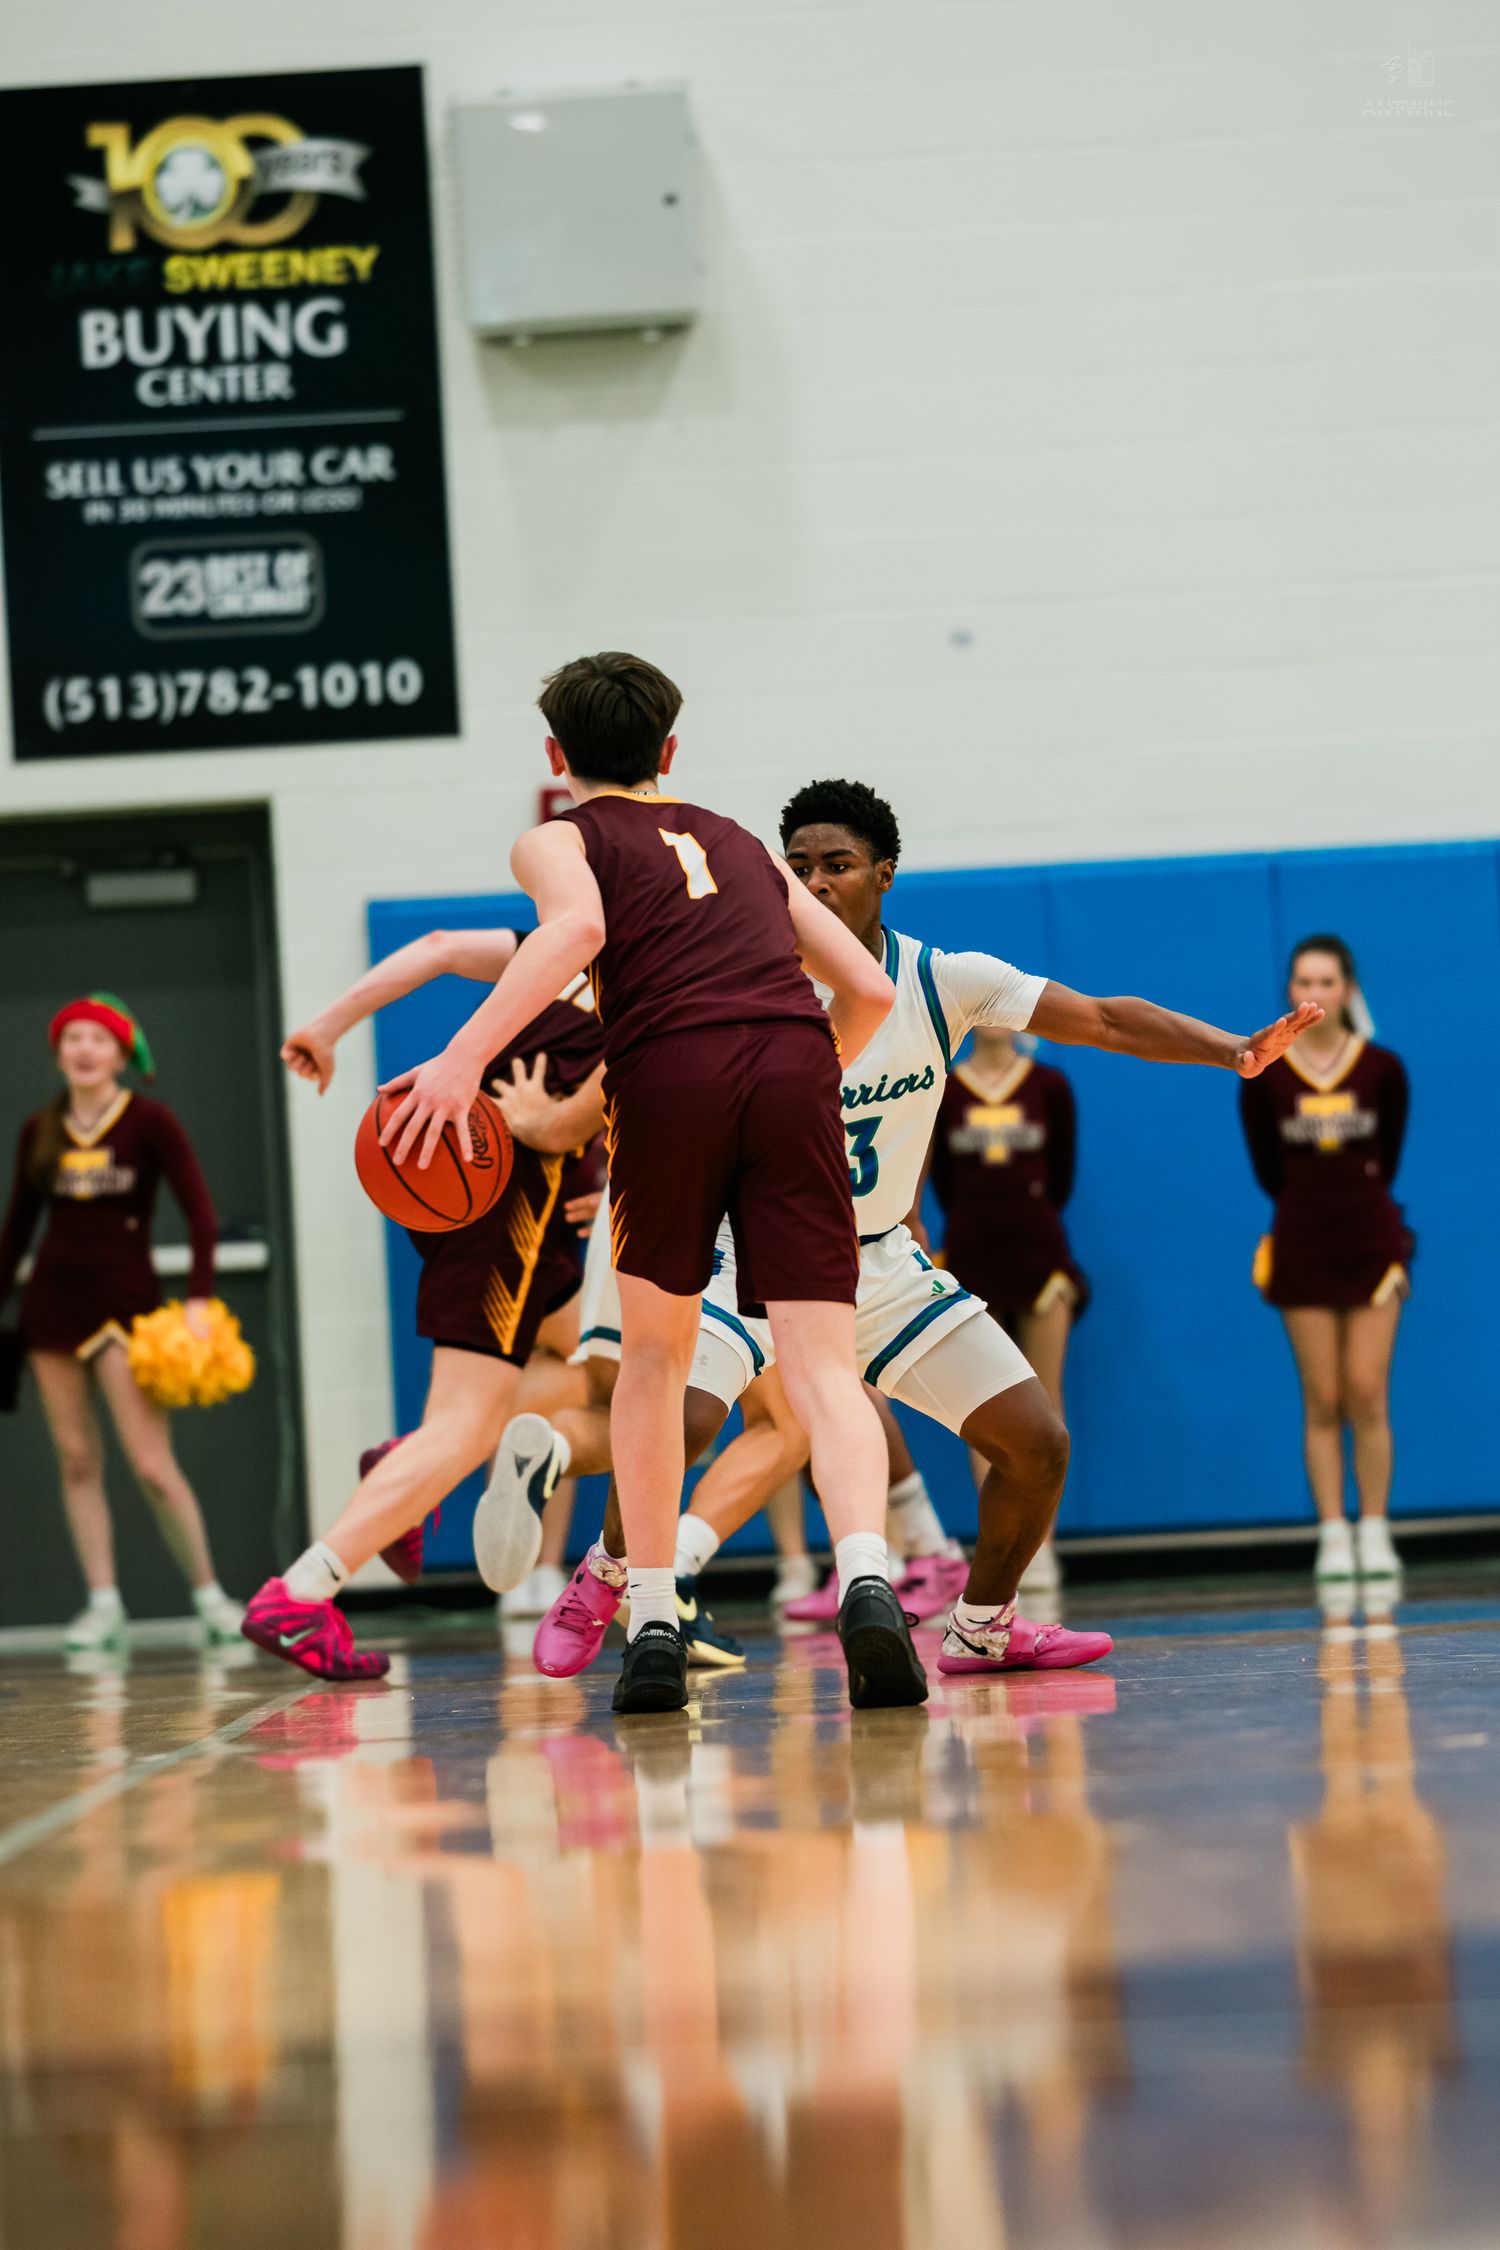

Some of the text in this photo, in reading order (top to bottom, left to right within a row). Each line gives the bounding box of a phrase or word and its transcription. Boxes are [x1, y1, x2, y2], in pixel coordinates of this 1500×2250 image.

[86, 113, 318, 253] 100
[162, 245, 380, 293] SWEENEY
[79, 296, 348, 370] BUYING
[135, 362, 294, 407] CENTER
[45, 444, 396, 500] SELL US YOUR CAR
[140, 557, 205, 619] 23
[43, 656, 424, 733] (513)782-1010
[658, 828, 718, 899] 1
[842, 1065, 934, 1109] rriors
